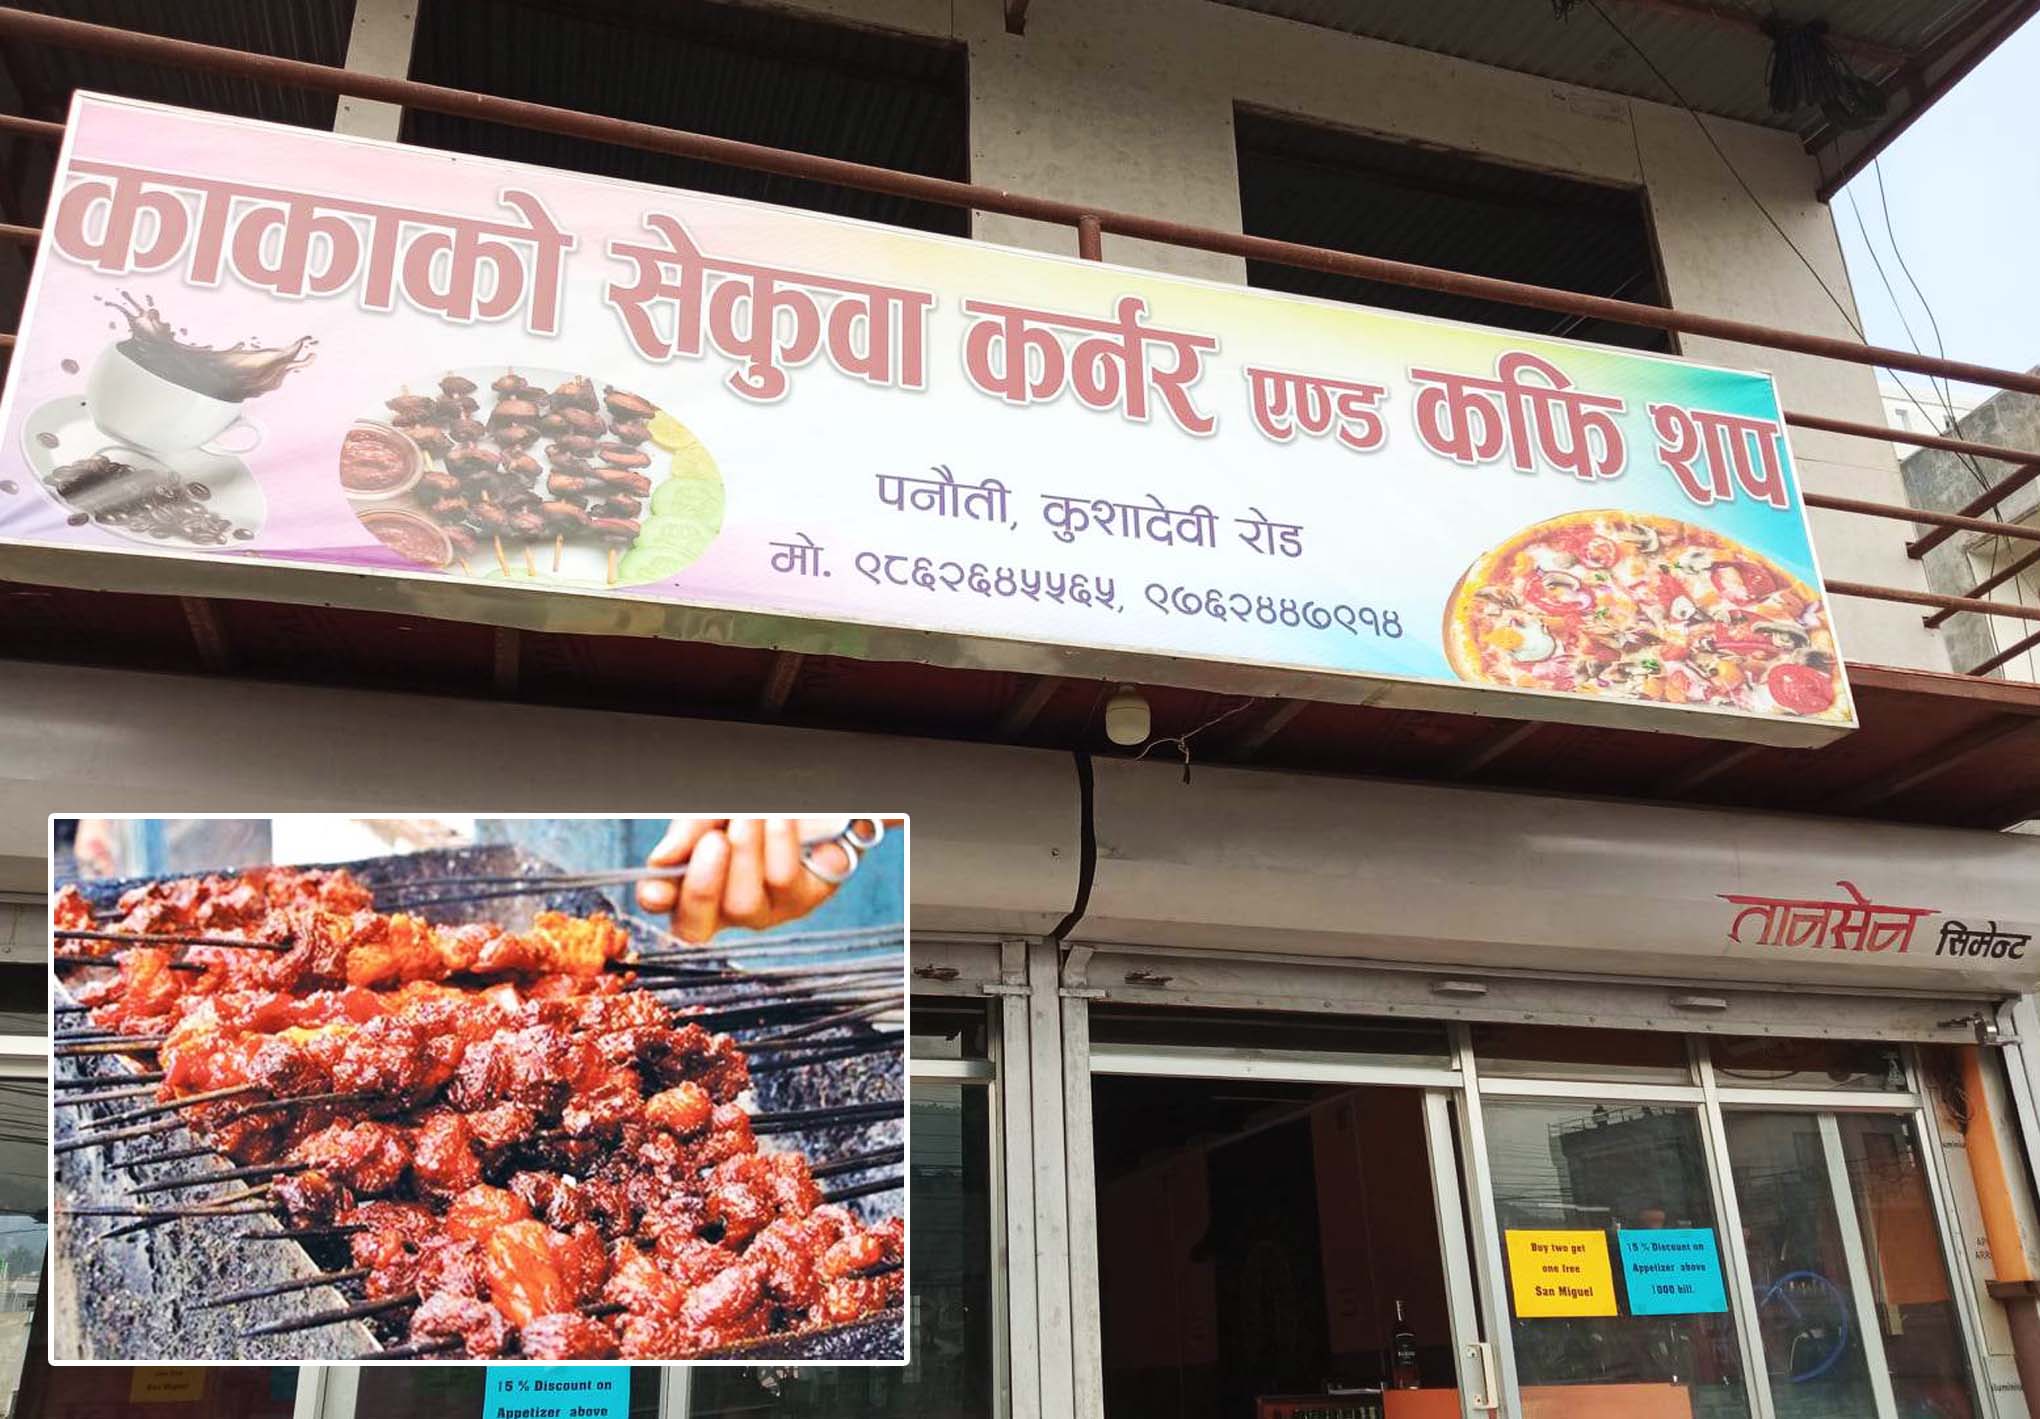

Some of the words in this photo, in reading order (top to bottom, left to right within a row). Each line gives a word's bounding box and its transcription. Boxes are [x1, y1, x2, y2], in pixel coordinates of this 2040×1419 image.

[52, 189, 575, 333] काकाको
[607, 213, 933, 398] सेकुवा
[964, 297, 1216, 433] कर्नर
[1246, 367, 1385, 448] एण्ड
[1410, 353, 1625, 478] कफि
[1648, 404, 1789, 507] शप
[875, 464, 1017, 531] पनौती,
[1041, 493, 1219, 548] कुशादेवी
[1234, 507, 1304, 558] रोड
[769, 532, 831, 577] मो.
[1716, 880, 1942, 953] तानसेन
[1935, 919, 2032, 959] सिमेन्ट
[1530, 1243, 1548, 1254] Buy
[1552, 1244, 1568, 1252] two
[1571, 1244, 1585, 1254] get
[1651, 1243, 1691, 1252] Discount
[1693, 1243, 1704, 1251] on
[1542, 1265, 1559, 1273] one
[1562, 1264, 1580, 1273] free
[1632, 1263, 1675, 1275] Appetizer
[1681, 1263, 1706, 1272] above
[1535, 1286, 1555, 1296] San
[1558, 1286, 1593, 1299] Miguel
[1652, 1285, 1675, 1294] 1000
[498, 1381, 513, 1392] 15
[518, 1381, 530, 1392] %
[534, 1380, 592, 1392] Discount
[597, 1381, 612, 1390] on
[496, 1407, 561, 1419] Appetizer
[570, 1406, 608, 1418] above
